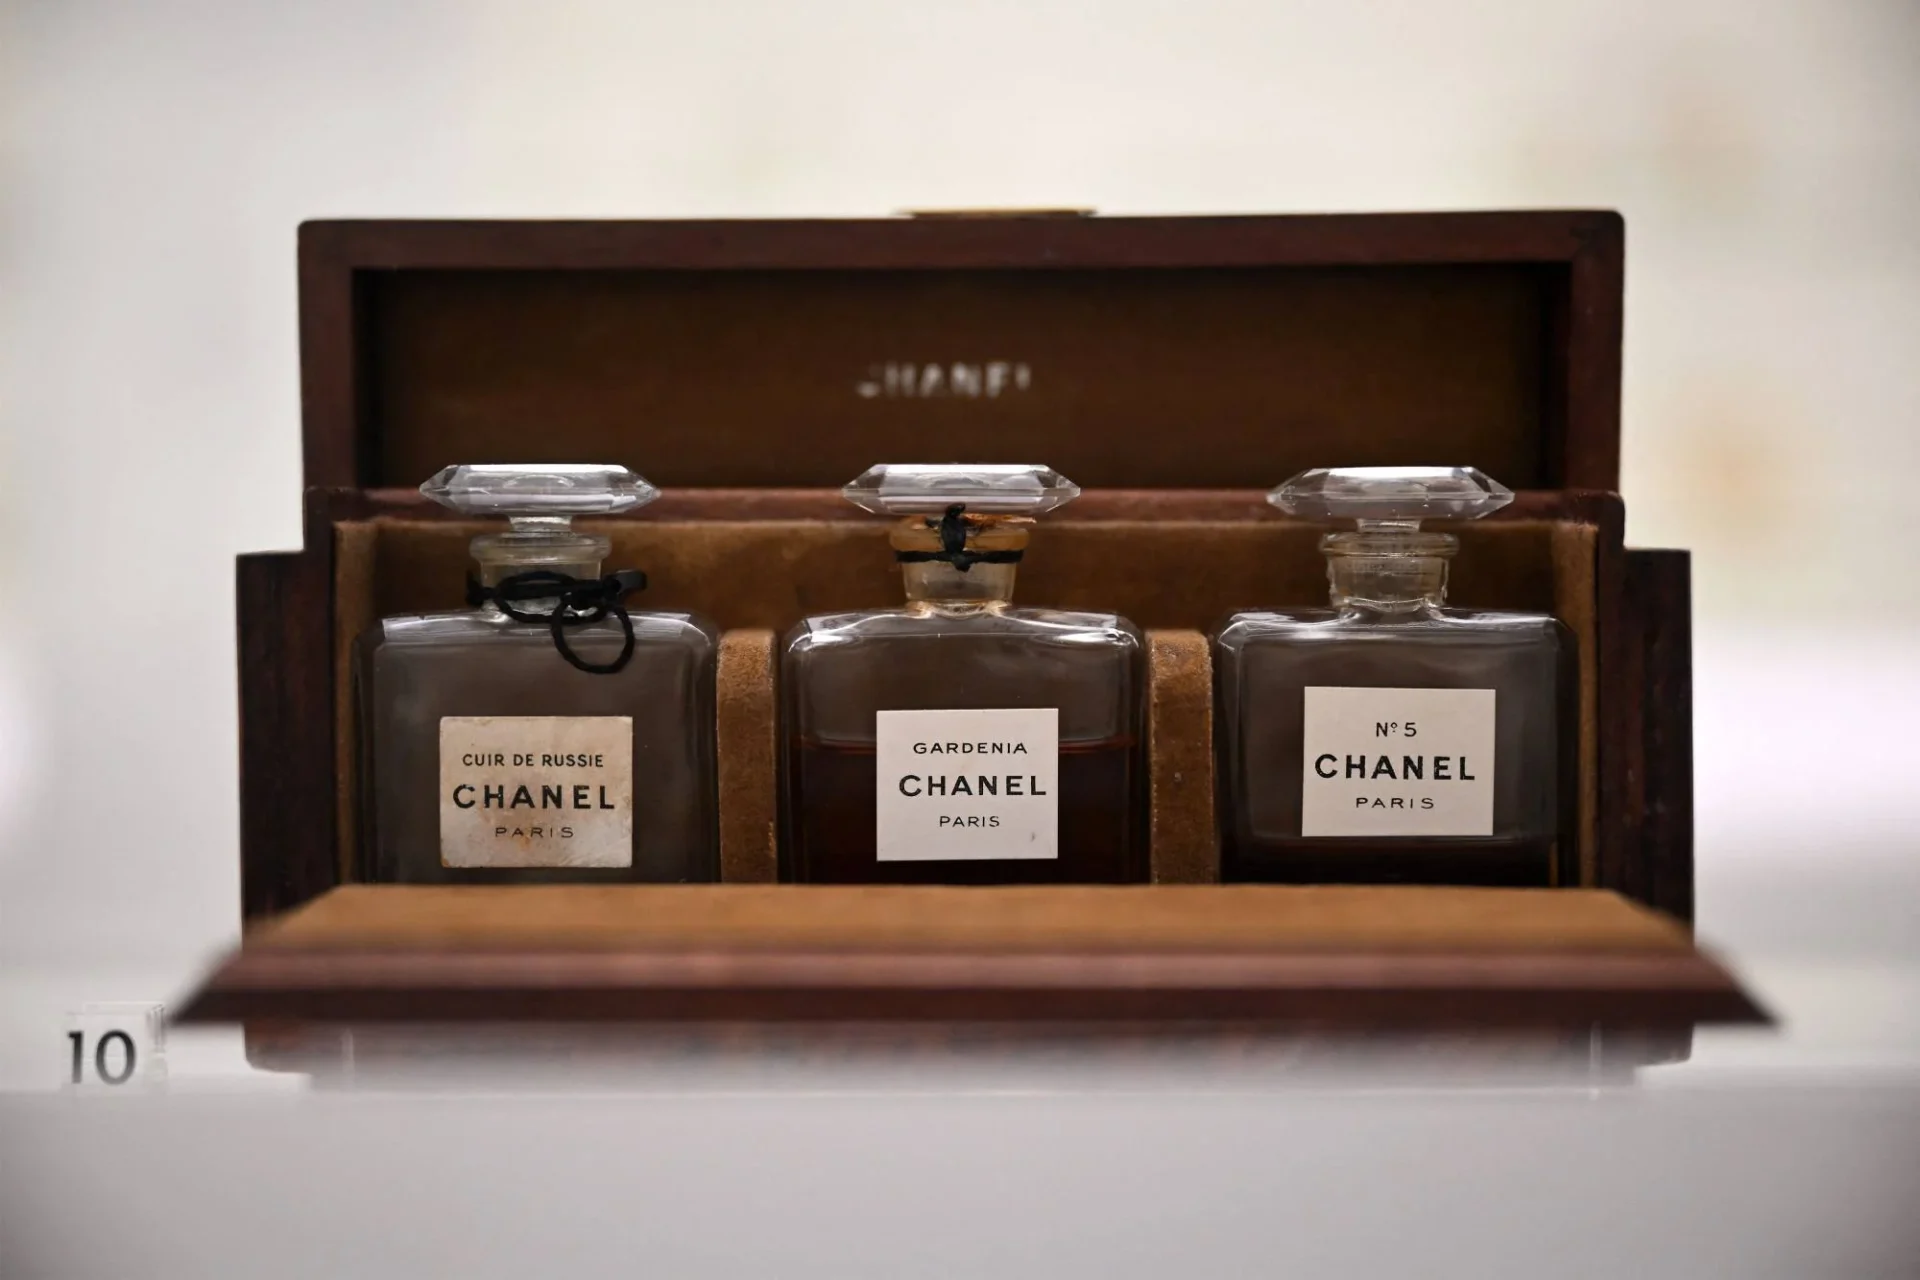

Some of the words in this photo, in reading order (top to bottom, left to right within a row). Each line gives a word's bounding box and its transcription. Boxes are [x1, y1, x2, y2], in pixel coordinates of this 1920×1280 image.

[1404, 722, 1417, 737] 5
[913, 742, 1028, 755] GARDENIA
[462, 753, 505, 767] CUIR
[513, 754, 534, 767] DE
[542, 754, 604, 768] RUSSIE
[1315, 753, 1475, 781] CHANEL
[899, 774, 1047, 797] CHANEL
[453, 784, 615, 810] CHANEL
[1356, 797, 1434, 809] PARIS
[939, 815, 1000, 828] PARIS
[495, 826, 574, 838] PARIS
[67, 1029, 136, 1086] 10
